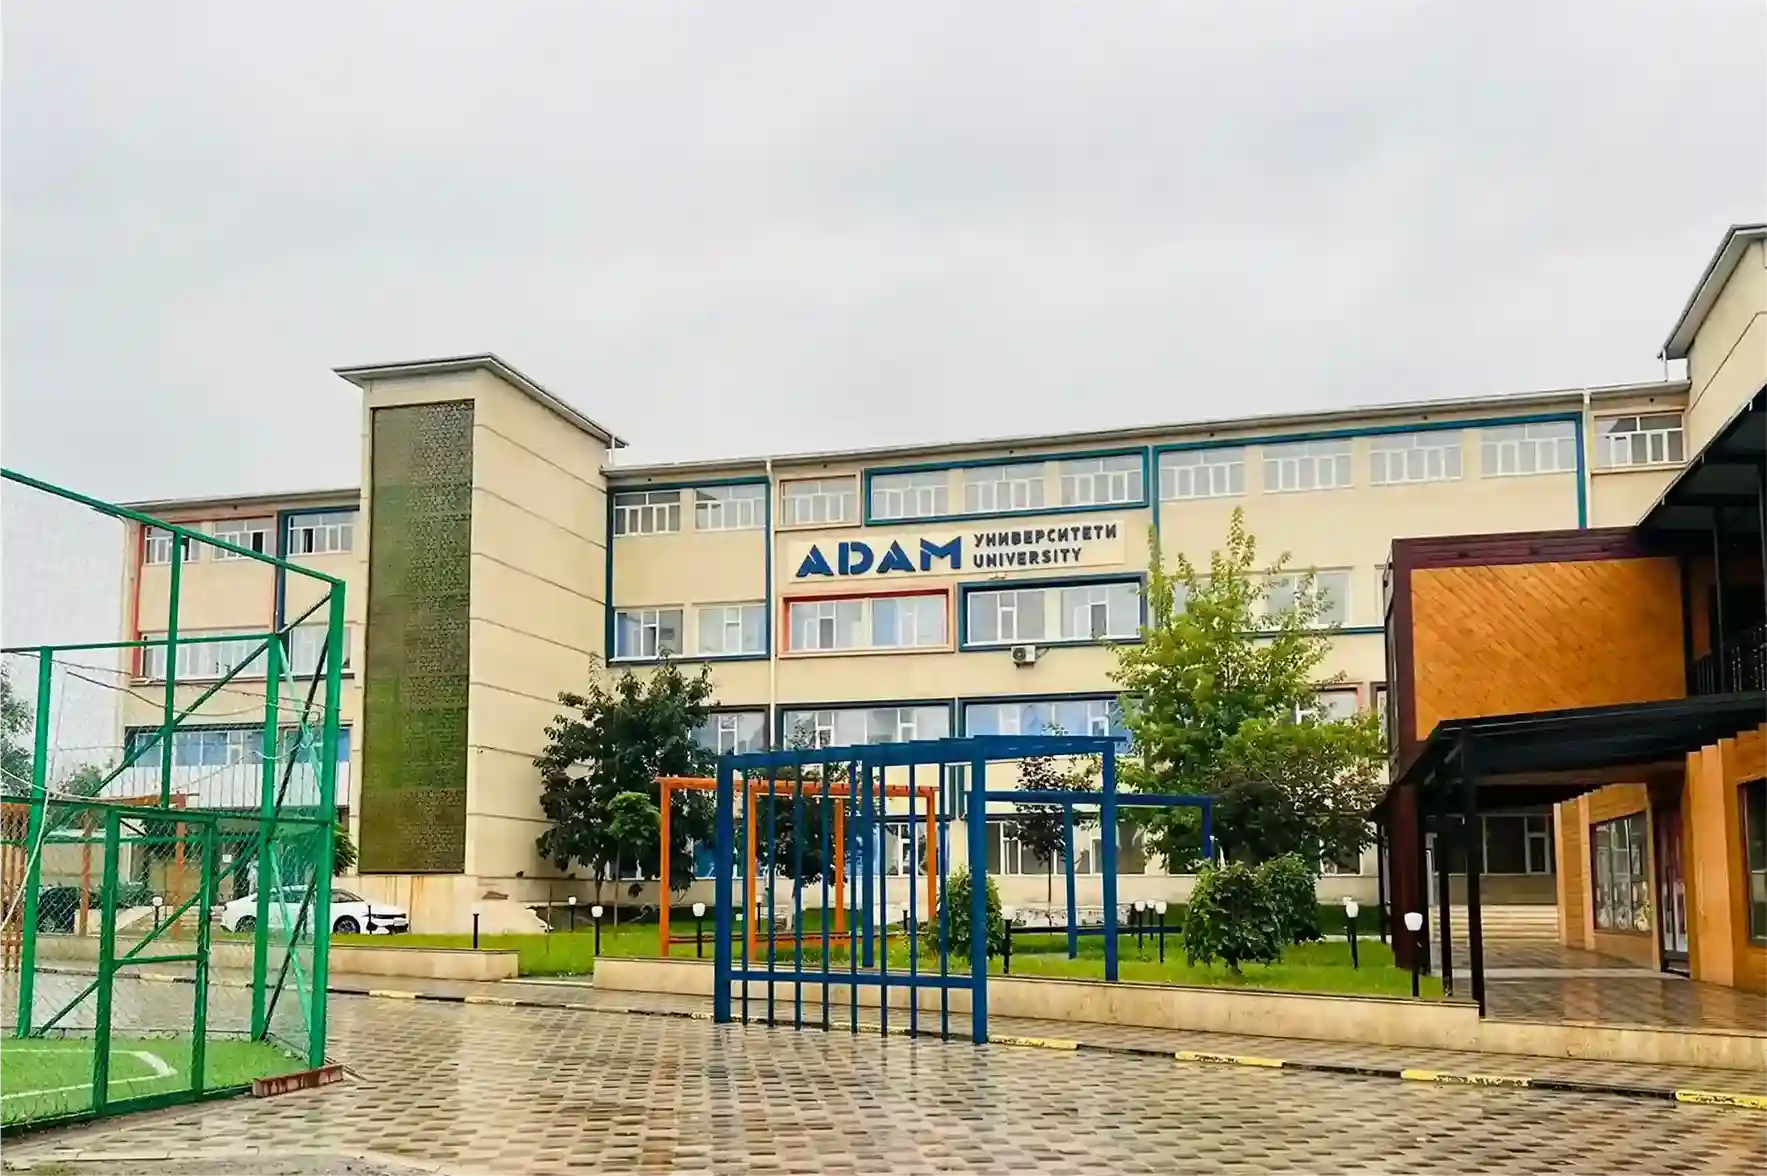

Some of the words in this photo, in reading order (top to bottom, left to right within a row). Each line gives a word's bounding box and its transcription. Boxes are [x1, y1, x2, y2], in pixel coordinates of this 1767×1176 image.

[973, 523, 1118, 548] УНИВЕРСИТЕТИ
[796, 536, 962, 578] ADAM
[973, 547, 1083, 568] UNIVERSITY
